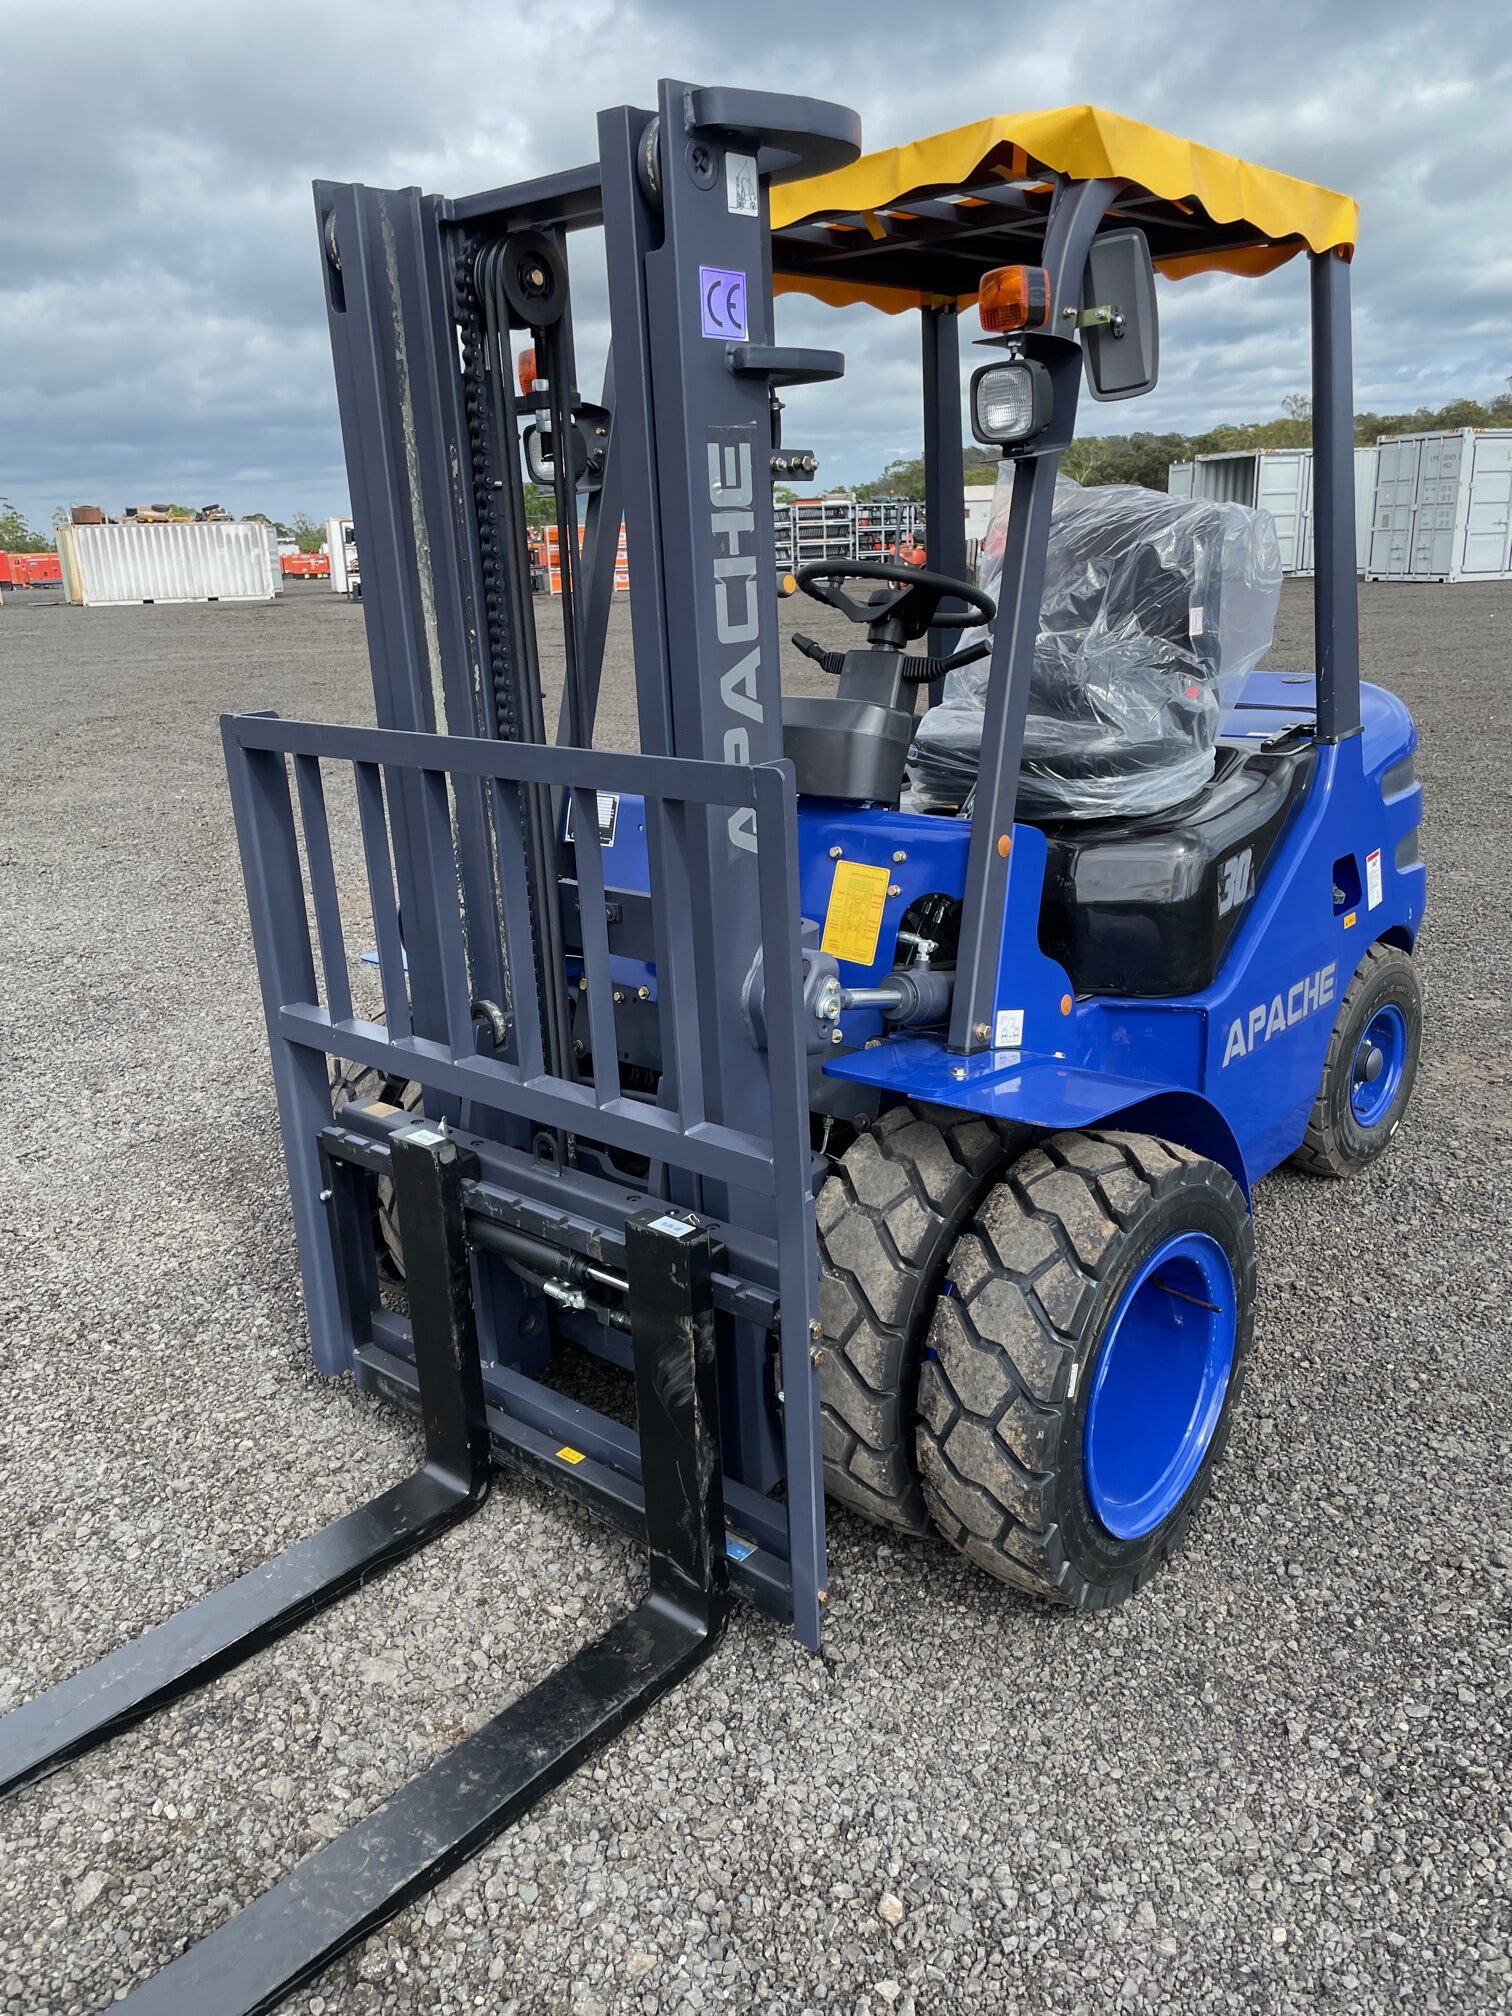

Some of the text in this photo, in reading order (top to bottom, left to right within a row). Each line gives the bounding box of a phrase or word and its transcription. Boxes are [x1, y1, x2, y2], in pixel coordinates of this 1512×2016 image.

[707, 280, 742, 330] CE
[1219, 848, 1252, 917] 30
[1222, 962, 1336, 1068] APACHE
